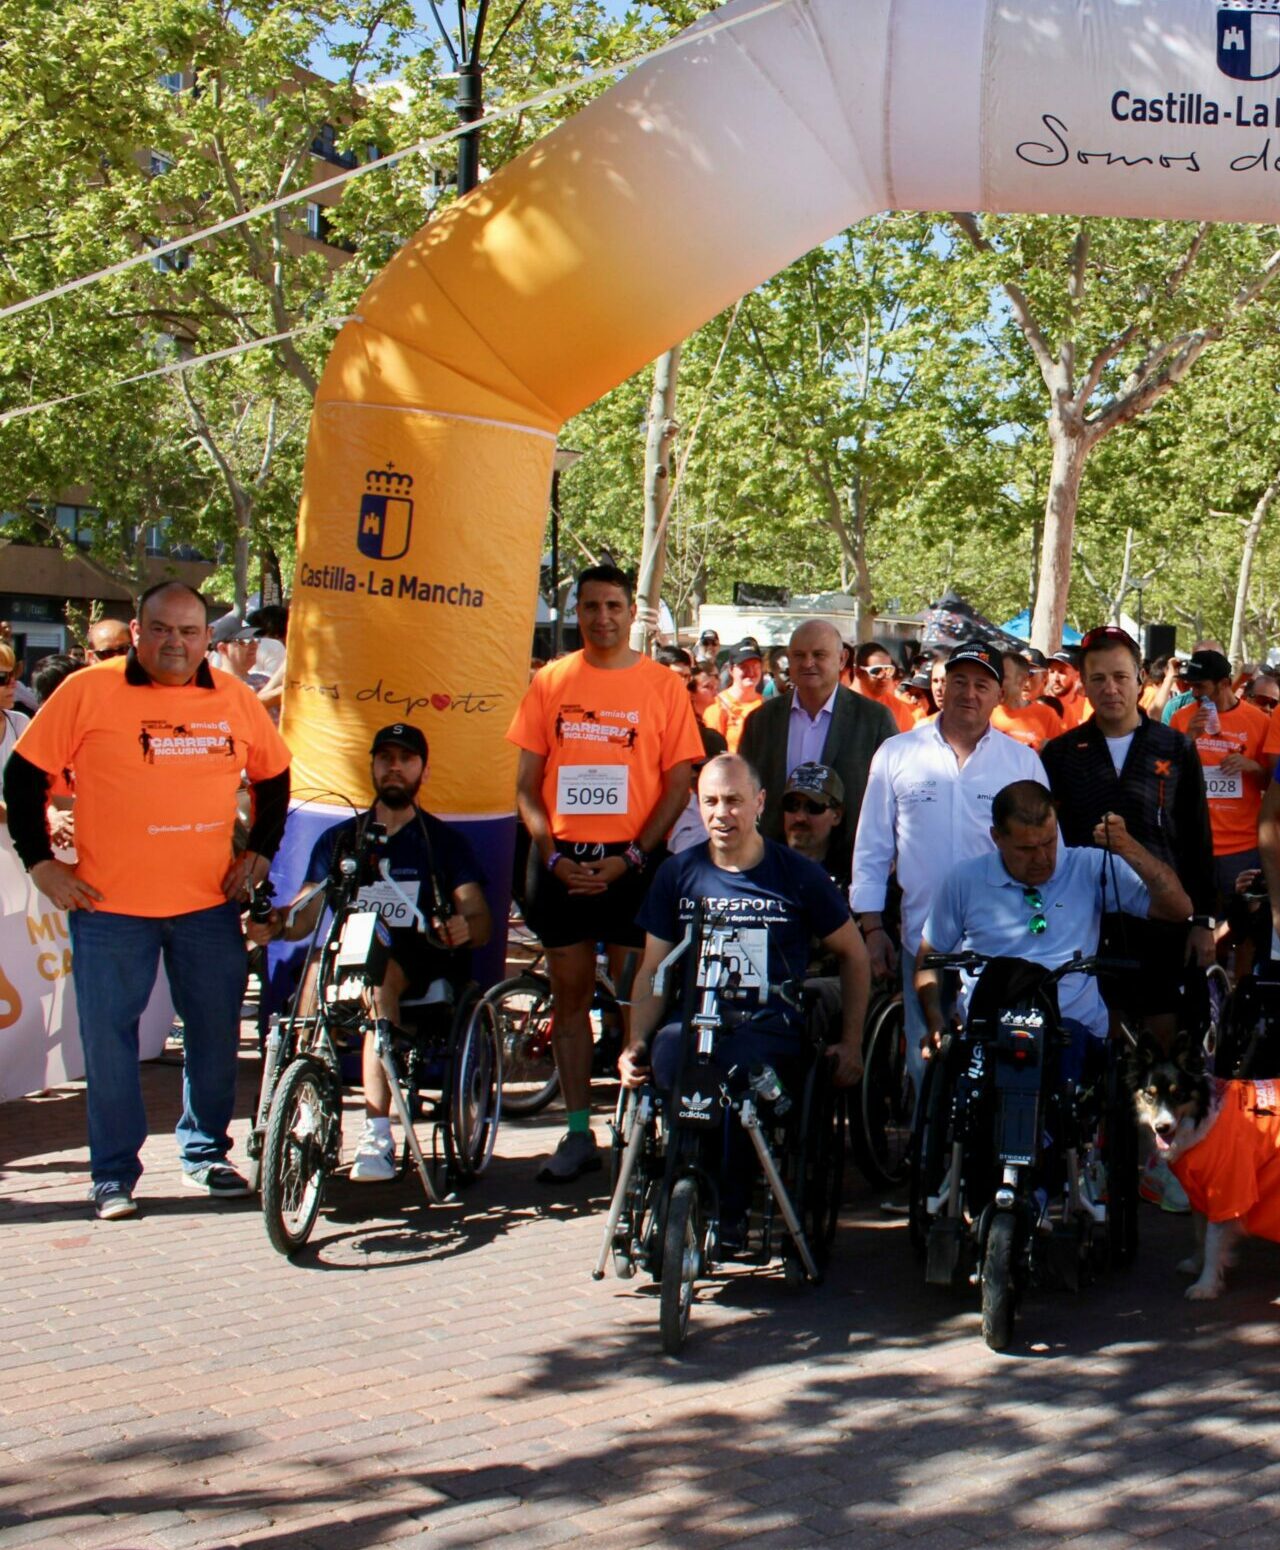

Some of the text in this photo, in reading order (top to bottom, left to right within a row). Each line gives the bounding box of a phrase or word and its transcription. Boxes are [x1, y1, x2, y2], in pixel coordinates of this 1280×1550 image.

[1015, 113, 1201, 173] Somos
[398, 574, 485, 608] Mancha
[392, 724, 404, 735] S
[561, 721, 629, 737] CARRERA
[149, 737, 227, 749] CARRERA
[154, 747, 209, 756] INCLUSIVA
[565, 787, 619, 806] 5096
[678, 1110, 711, 1120] adidas
